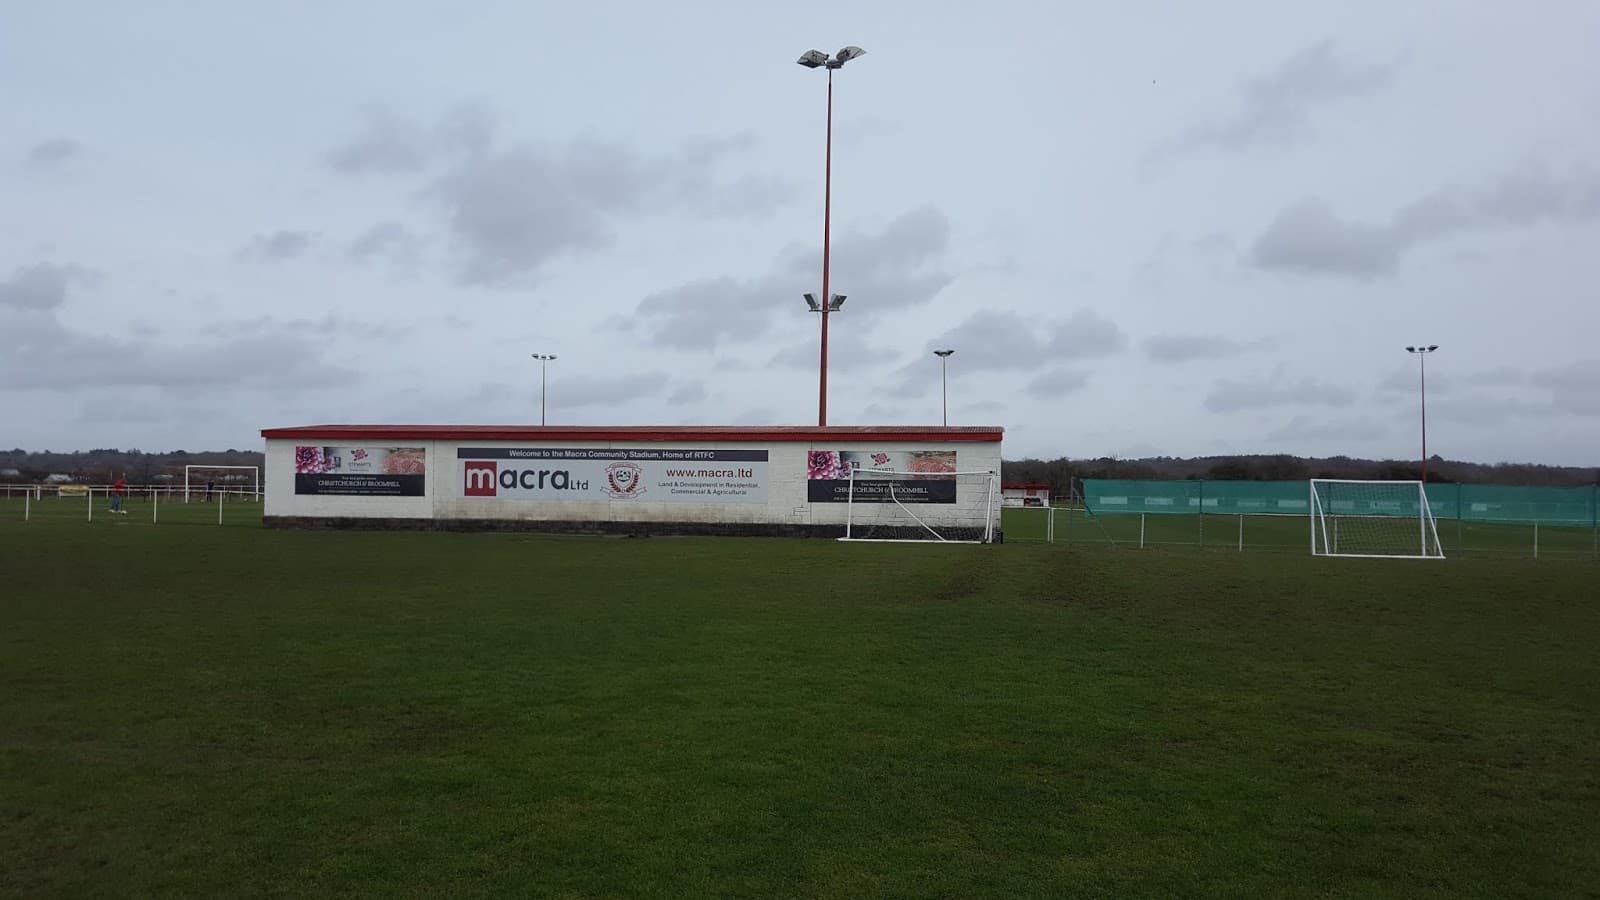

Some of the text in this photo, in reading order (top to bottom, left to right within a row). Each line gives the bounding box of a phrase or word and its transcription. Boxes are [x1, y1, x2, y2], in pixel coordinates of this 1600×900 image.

[508, 449, 541, 457] Welcome
[564, 450, 587, 458] Macra
[588, 450, 628, 459] Community
[629, 450, 661, 459] Stadium,
[662, 451, 683, 459] Home
[684, 451, 692, 459] of
[694, 451, 715, 459] RTFC
[666, 468, 753, 478] www.macra.ltd
[466, 468, 589, 490] macra Ltd
